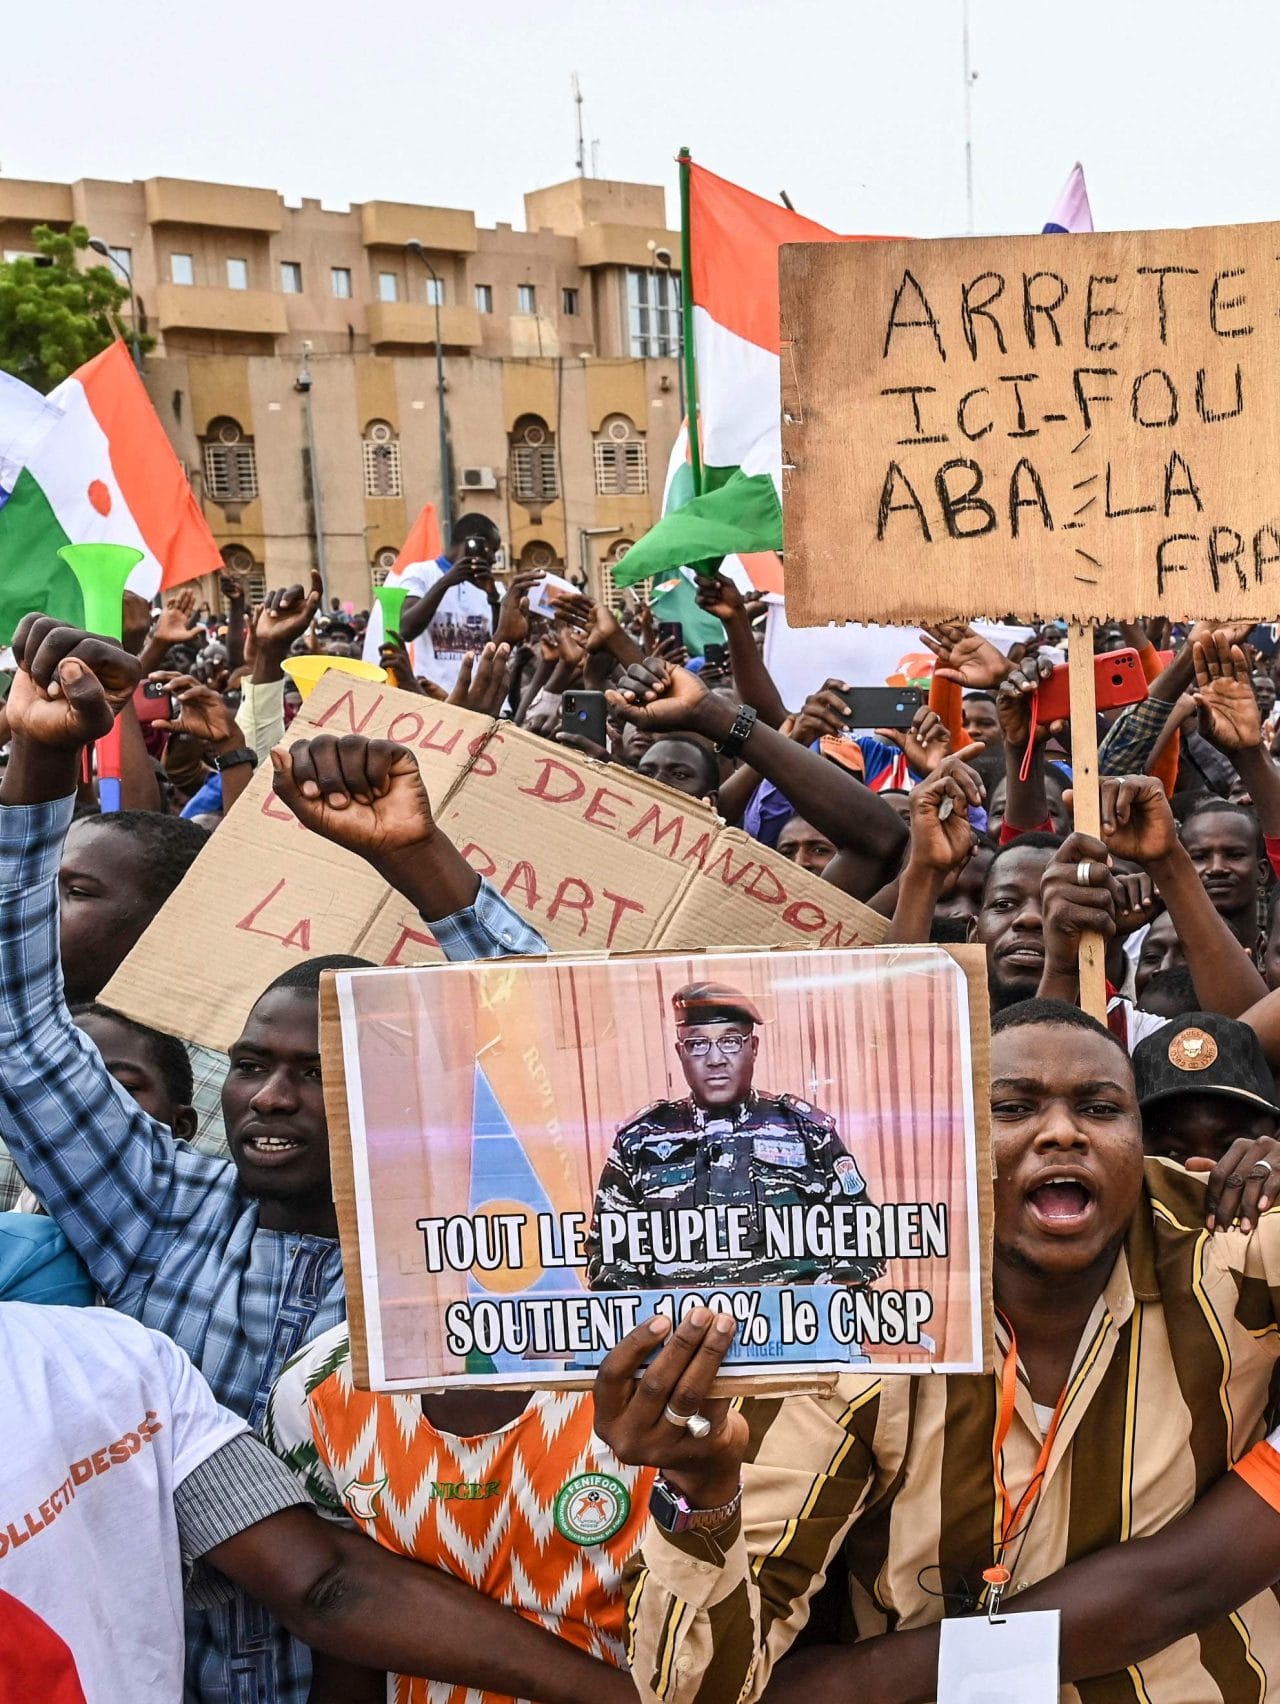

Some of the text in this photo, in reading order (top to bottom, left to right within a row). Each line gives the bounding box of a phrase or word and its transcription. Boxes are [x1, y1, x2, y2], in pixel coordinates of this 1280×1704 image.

[876, 450, 1204, 543] ABA LA
[309, 690, 876, 947] NOUS DEMANDON
[235, 878, 311, 951] LA
[416, 1202, 950, 1272] TOUT LE PEUPLE NIGERIEN
[446, 1296, 642, 1356] SOUTIENT
[780, 1290, 819, 1344] le
[829, 1288, 934, 1345] CNSP
[746, 1341, 784, 1358] NIGER
[69, 1439, 131, 1487] DES
[430, 1480, 500, 1500] NIGER
[568, 1476, 623, 1496] FENIFOOT
